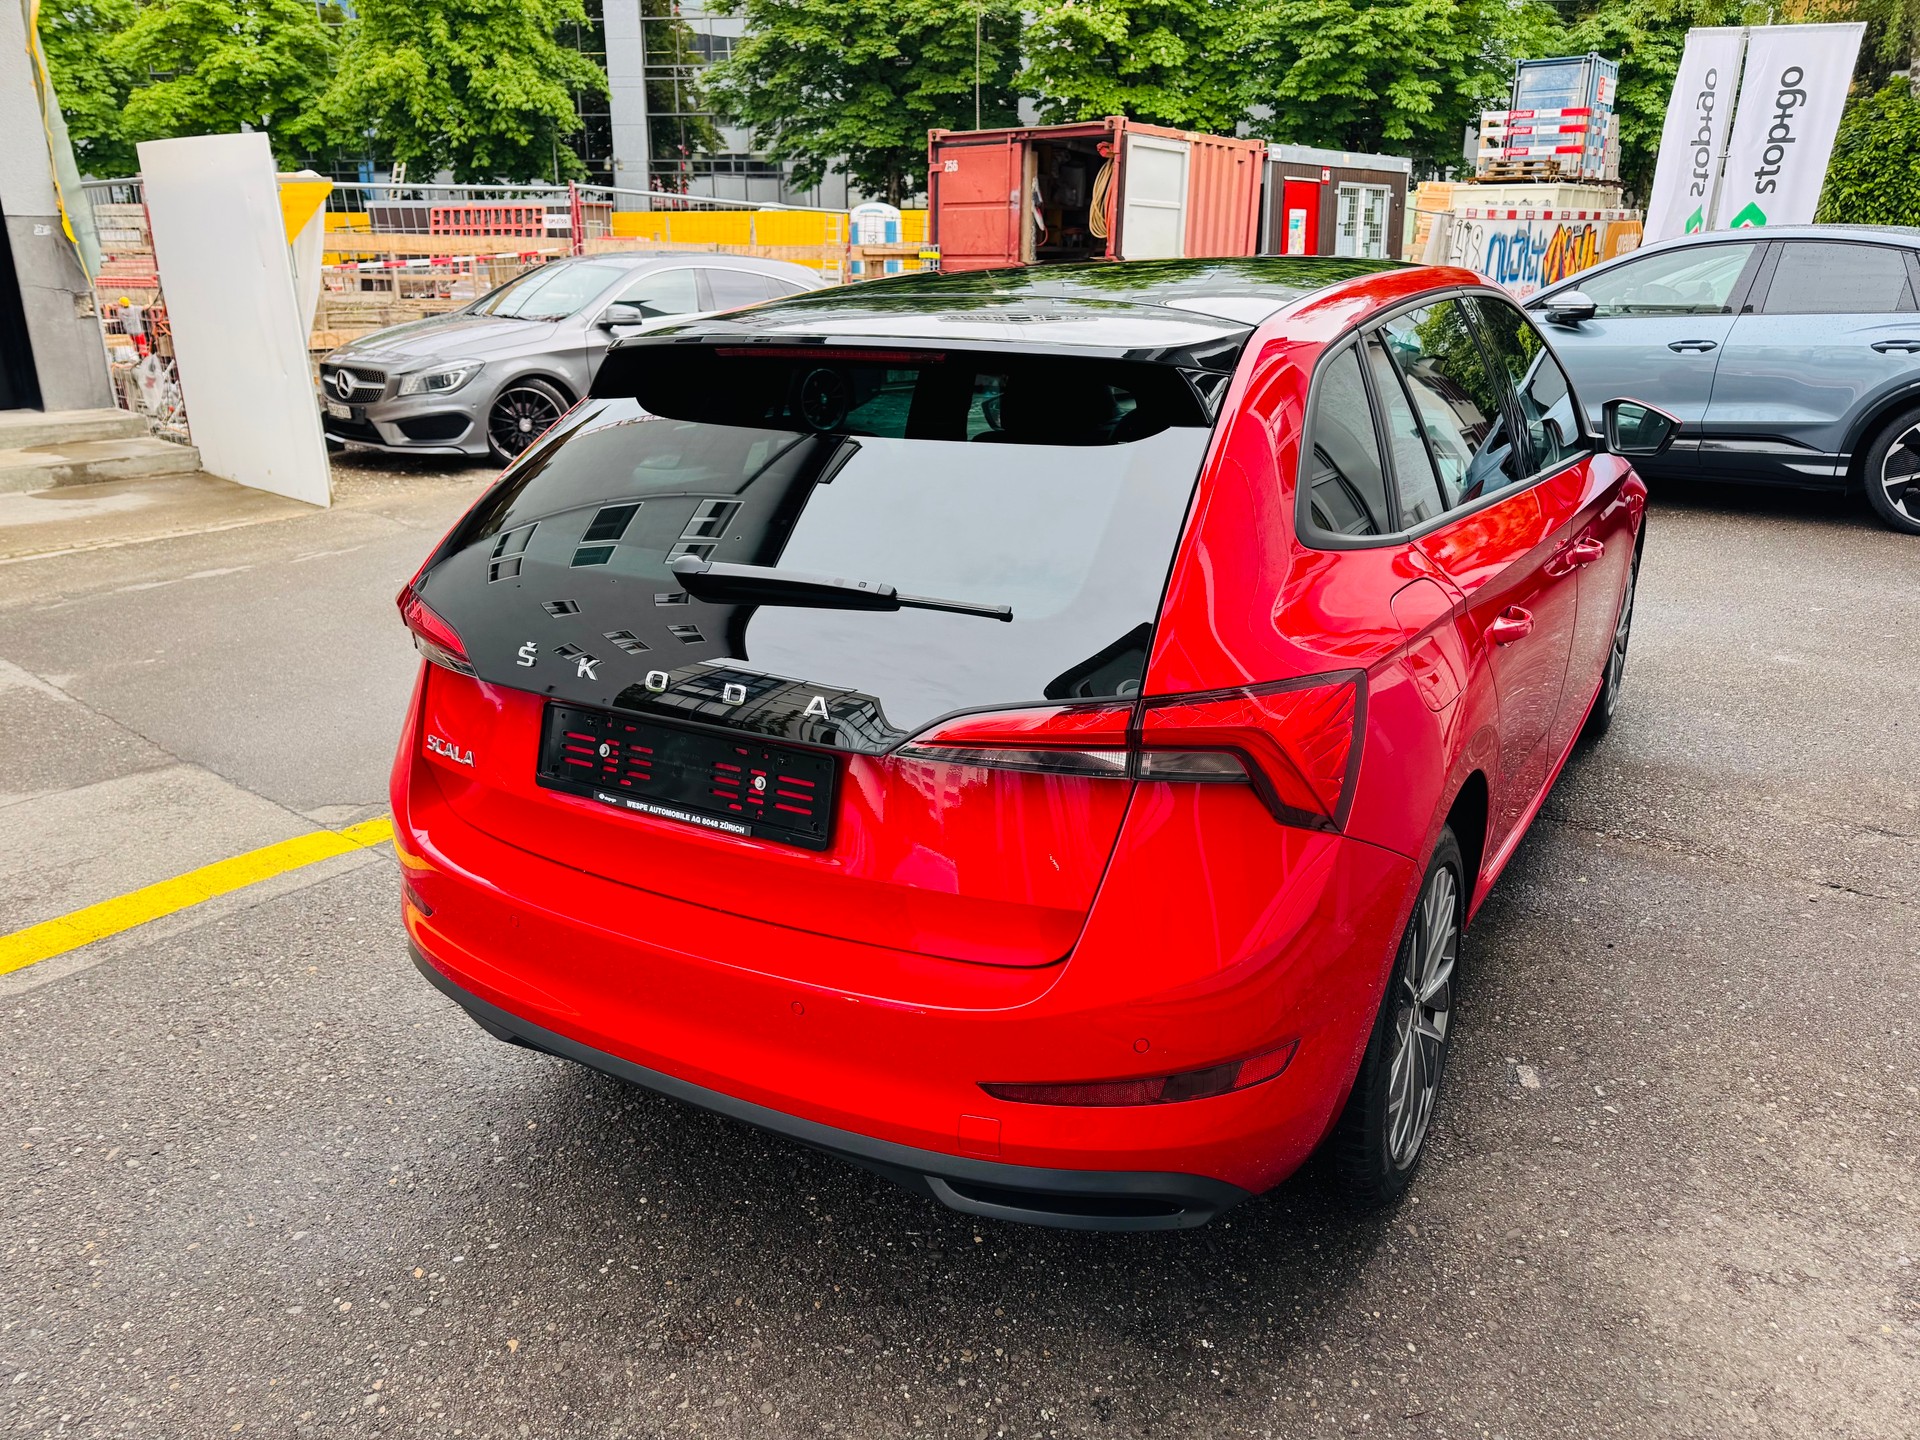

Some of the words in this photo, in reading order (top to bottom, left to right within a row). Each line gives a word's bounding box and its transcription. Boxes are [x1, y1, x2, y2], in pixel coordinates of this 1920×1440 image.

[1510, 111, 1533, 119] greuter
[1508, 127, 1532, 135] greuter
[1754, 66, 1807, 194] stop+go
[1505, 148, 1528, 156] greuter
[426, 734, 475, 768] SCALA
[626, 800, 649, 811] WESPE
[648, 805, 690, 821] AUTOMOBILE
[691, 815, 701, 824] AG
[702, 817, 719, 828] 8048
[719, 821, 745, 834] ZÜRICH
